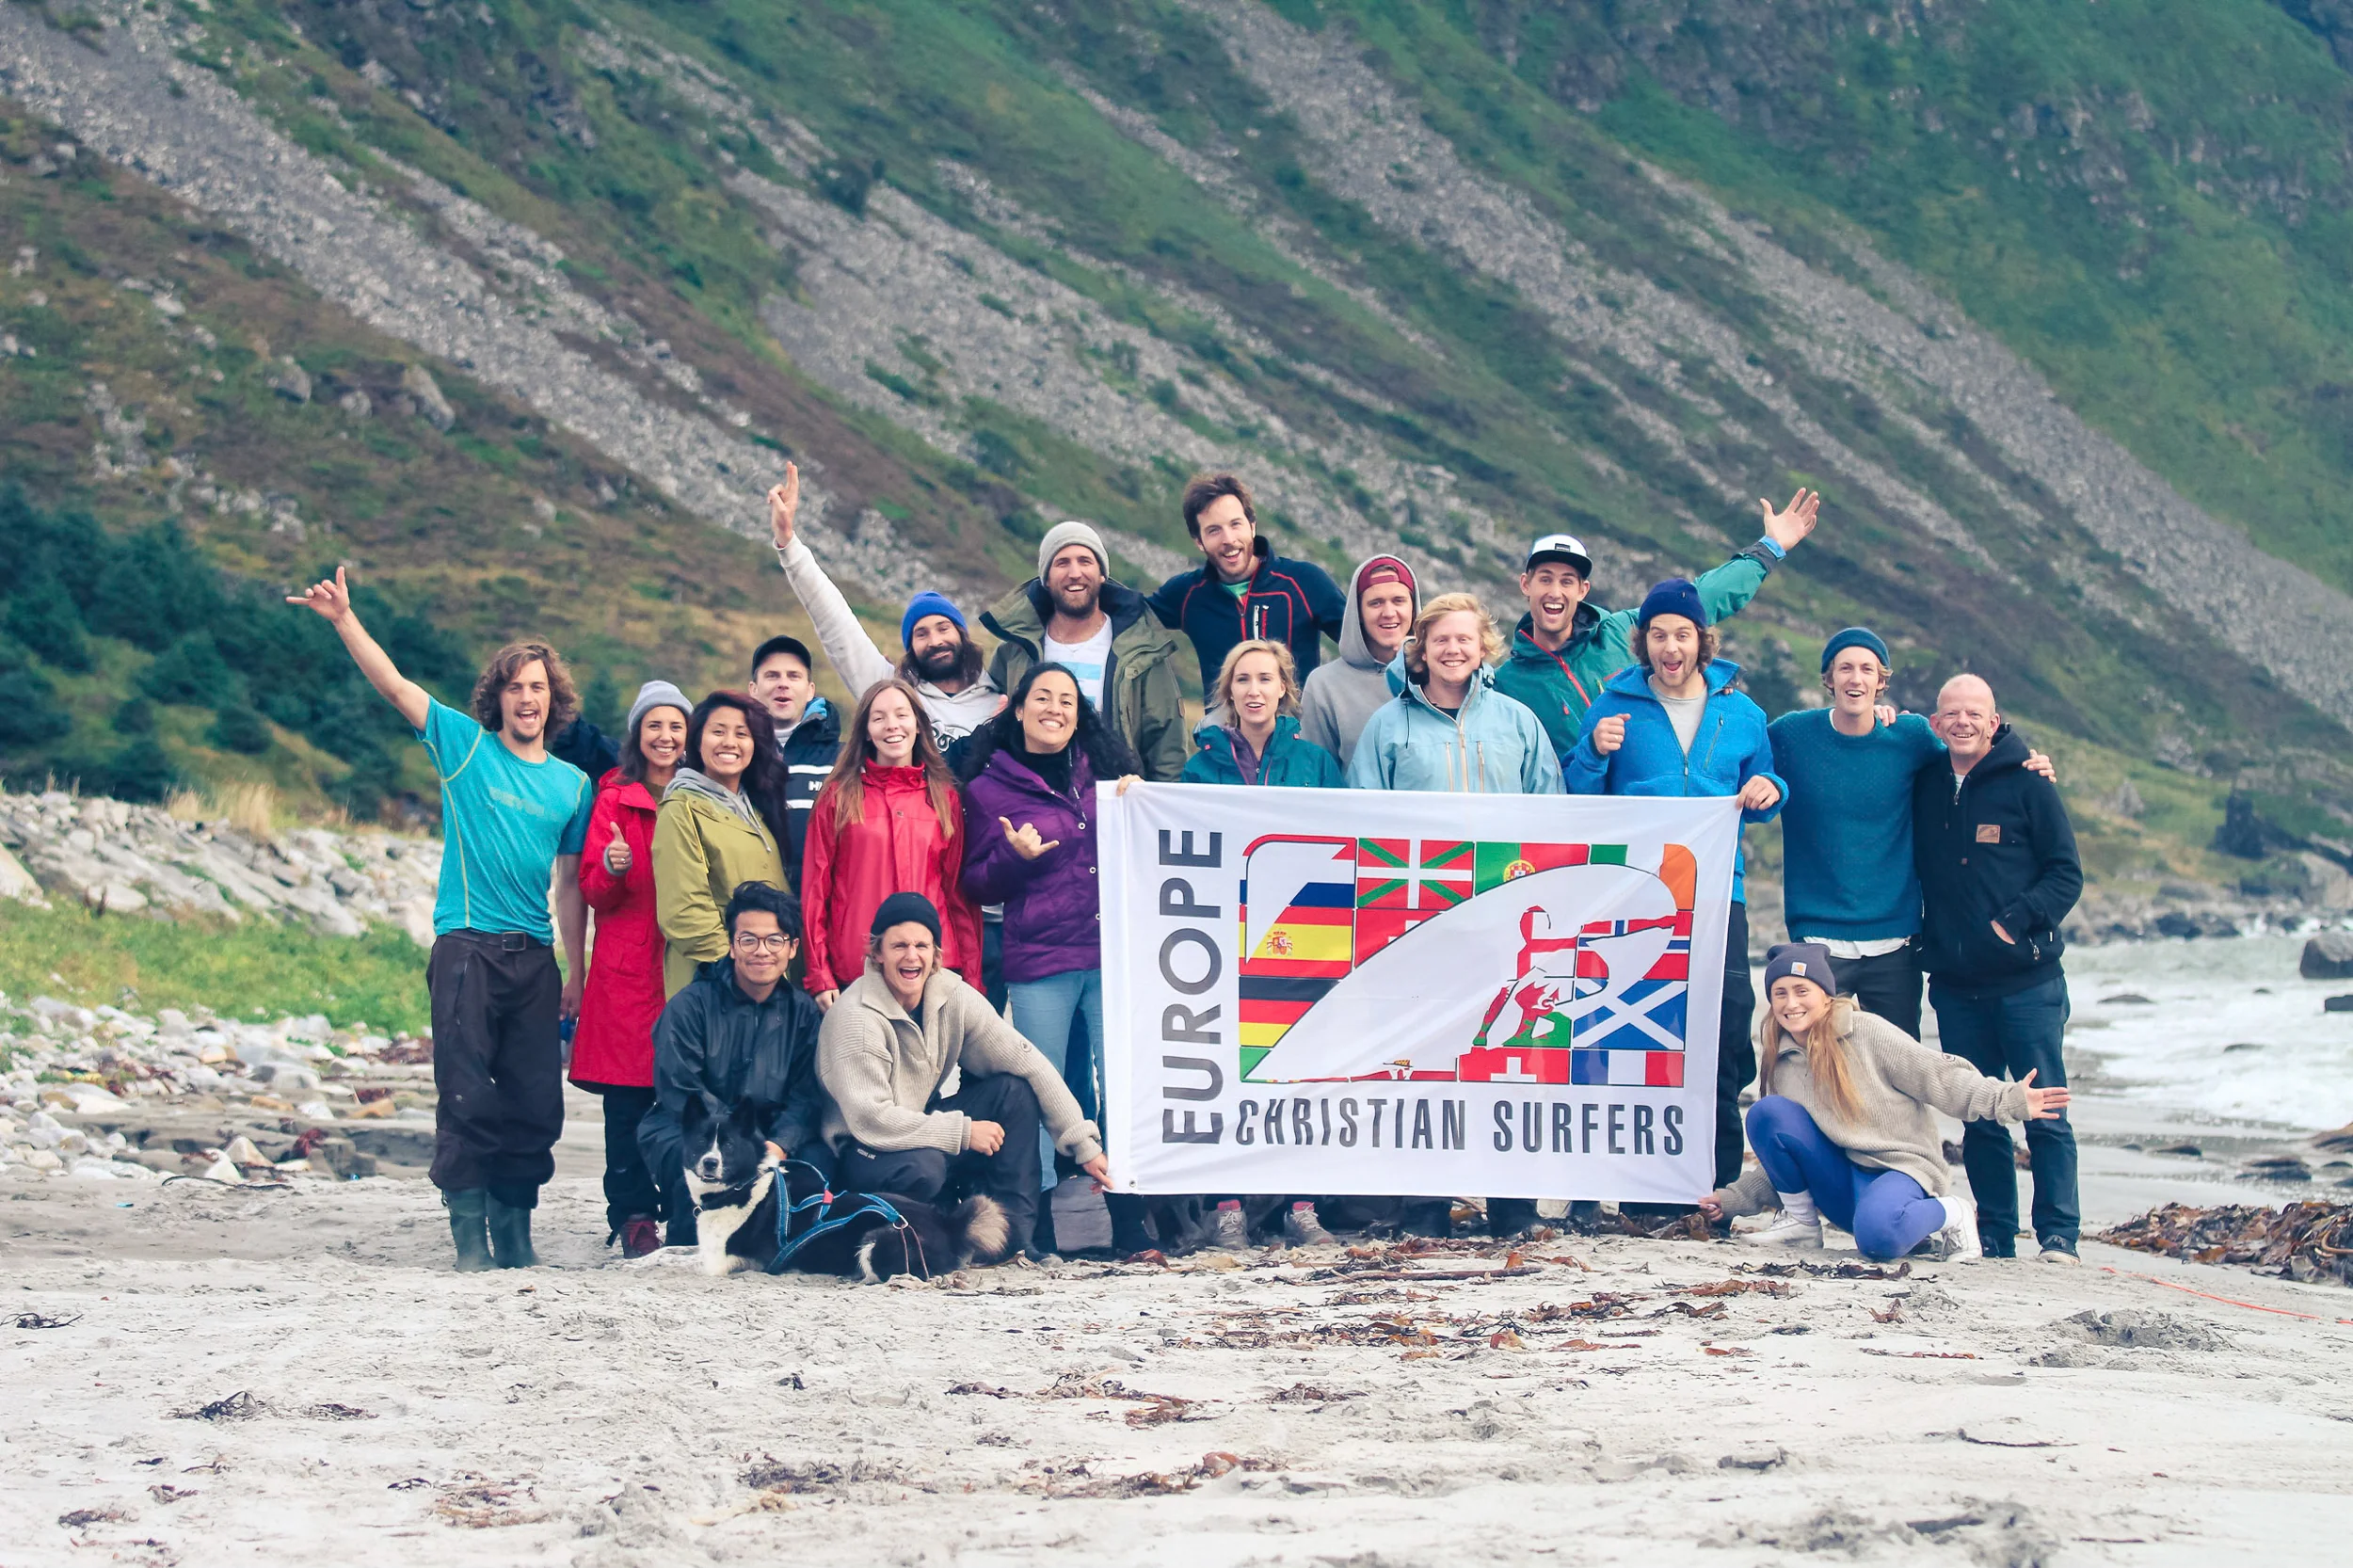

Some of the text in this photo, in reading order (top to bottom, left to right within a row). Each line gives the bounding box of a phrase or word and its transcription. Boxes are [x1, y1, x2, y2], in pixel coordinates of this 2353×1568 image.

[1158, 828, 1225, 1145] EUROPE
[1235, 1096, 1685, 1157] CHRISTIAN SURFERS
